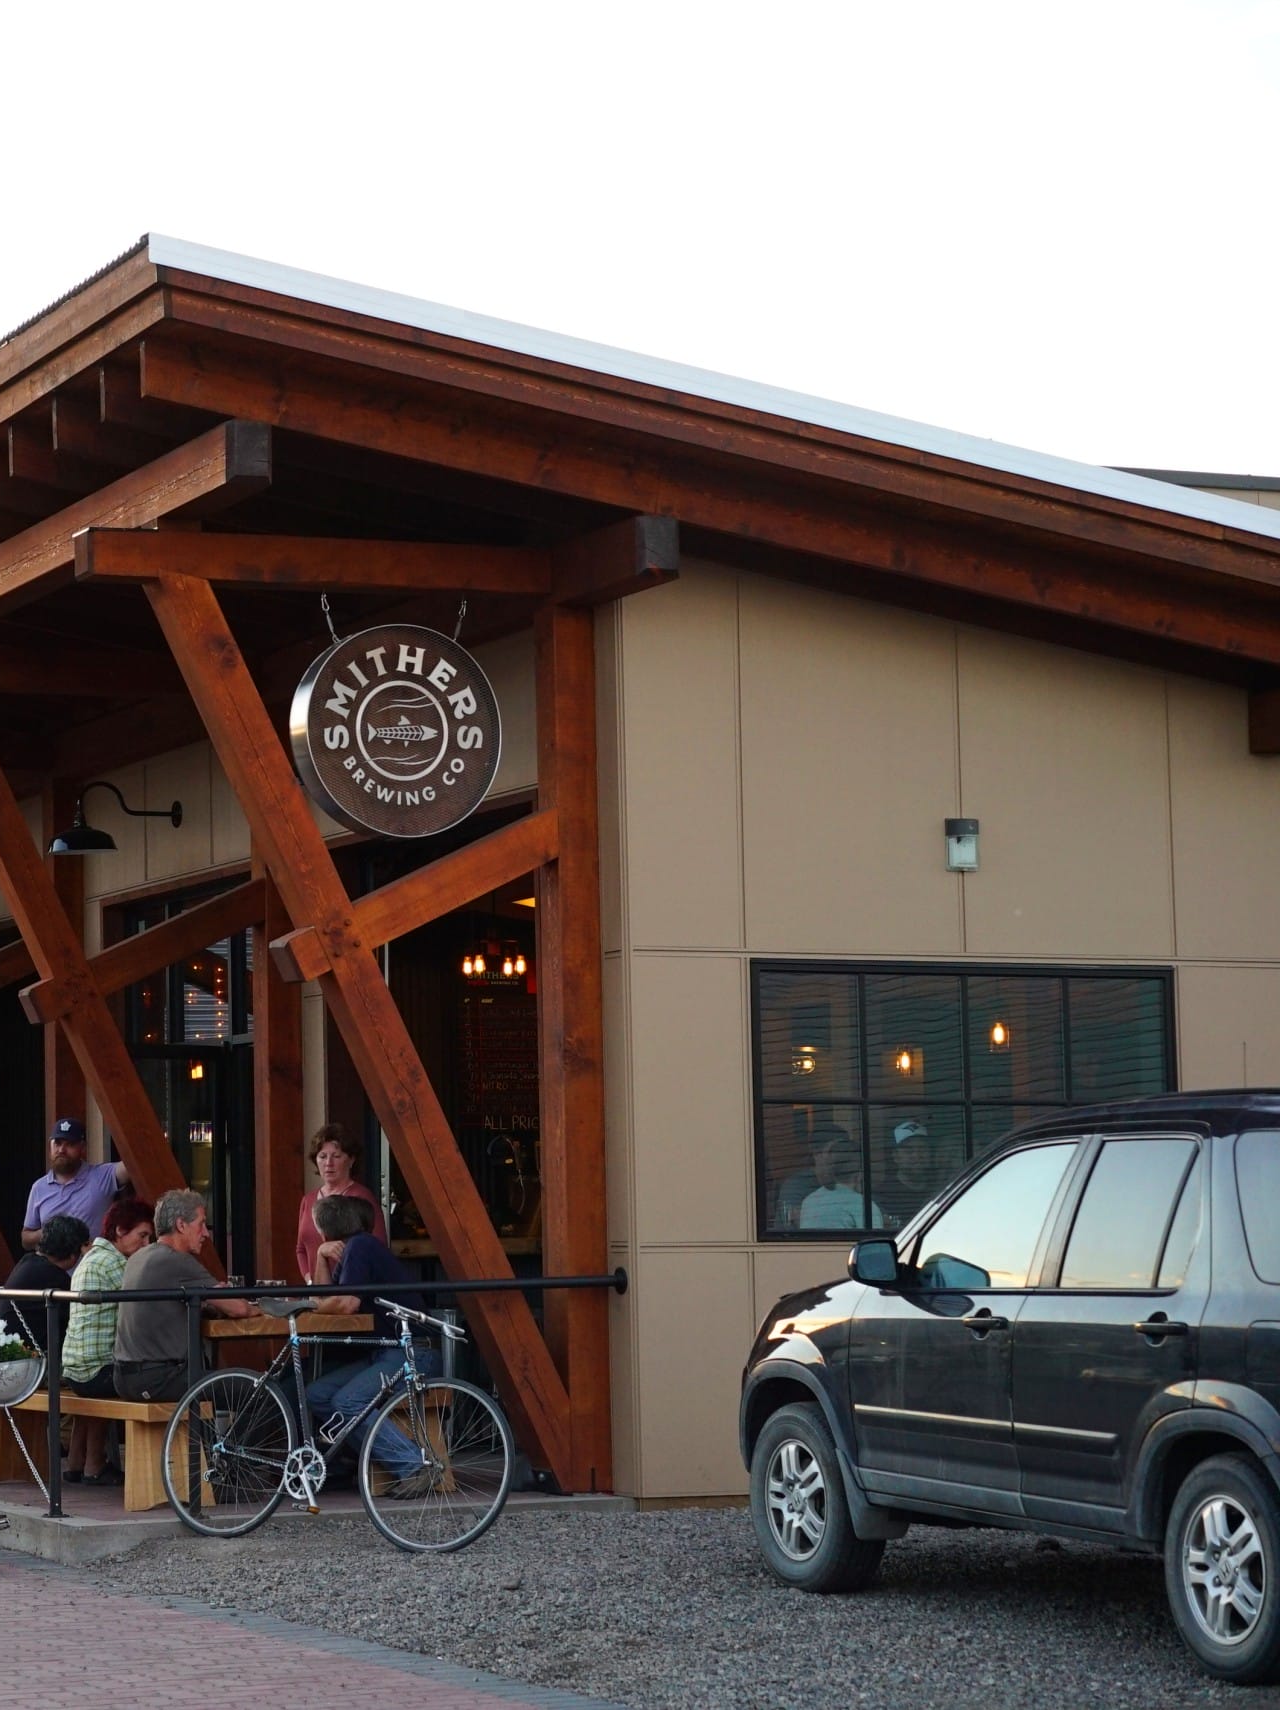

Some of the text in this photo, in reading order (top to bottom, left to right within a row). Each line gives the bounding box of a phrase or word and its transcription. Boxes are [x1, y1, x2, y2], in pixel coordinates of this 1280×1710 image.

[323, 644, 484, 751] SMITHERS
[342, 755, 465, 806] BREWING CO
[467, 971, 520, 980] SMITHES
[484, 1115, 508, 1130] ALL
